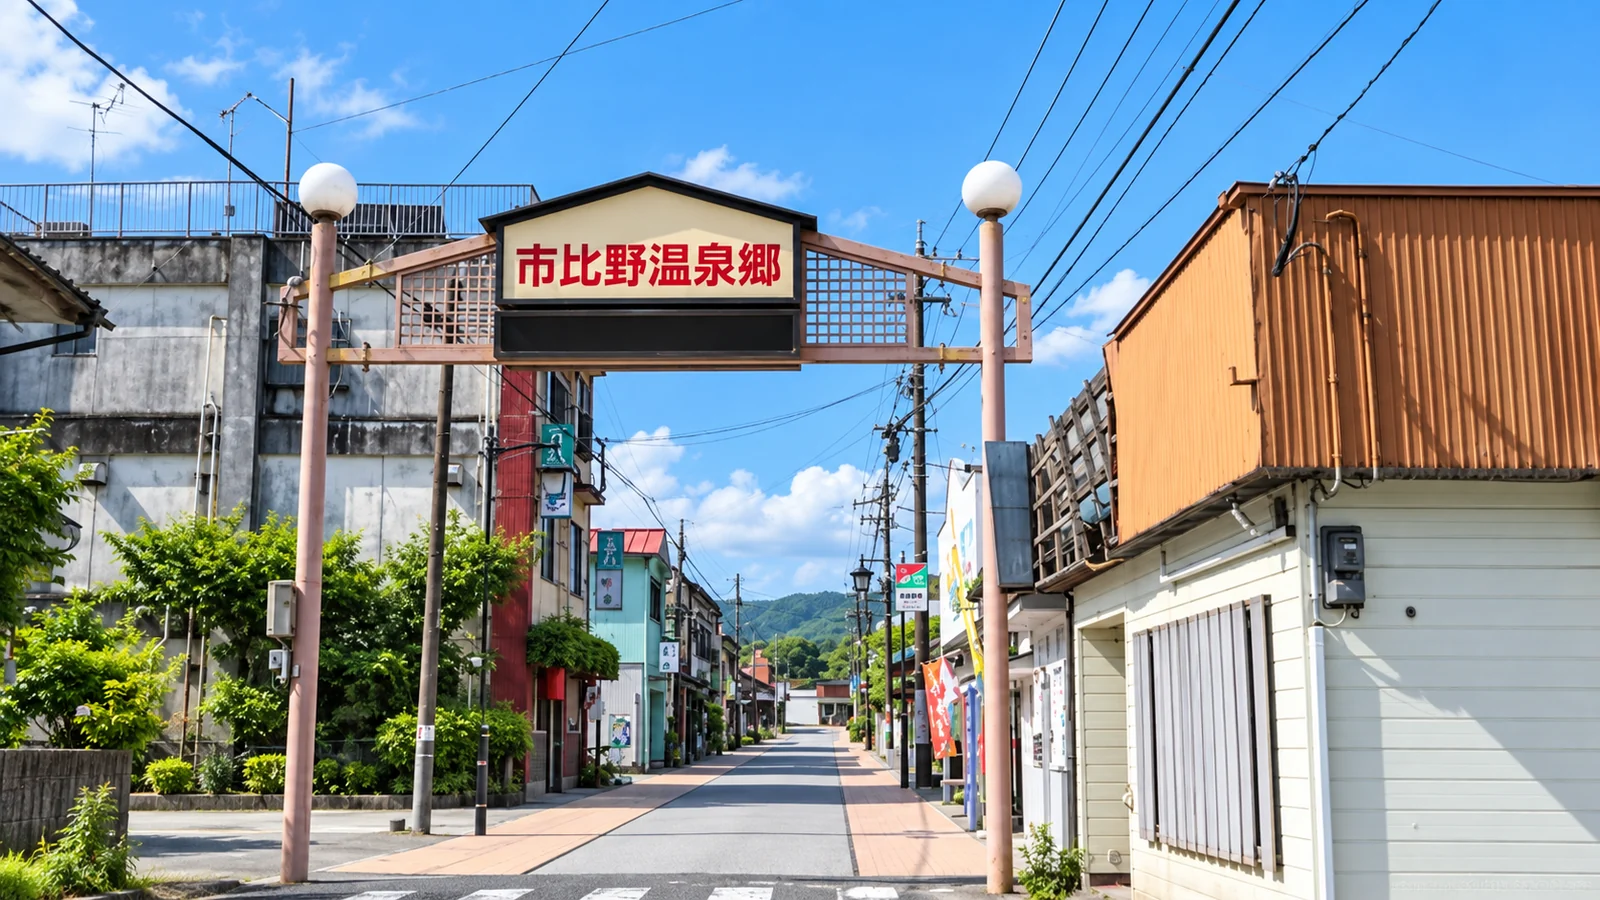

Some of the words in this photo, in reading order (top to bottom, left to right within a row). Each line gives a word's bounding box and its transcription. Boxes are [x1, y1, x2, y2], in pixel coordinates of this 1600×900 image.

[516, 242, 781, 287] 市比野温泉郷
